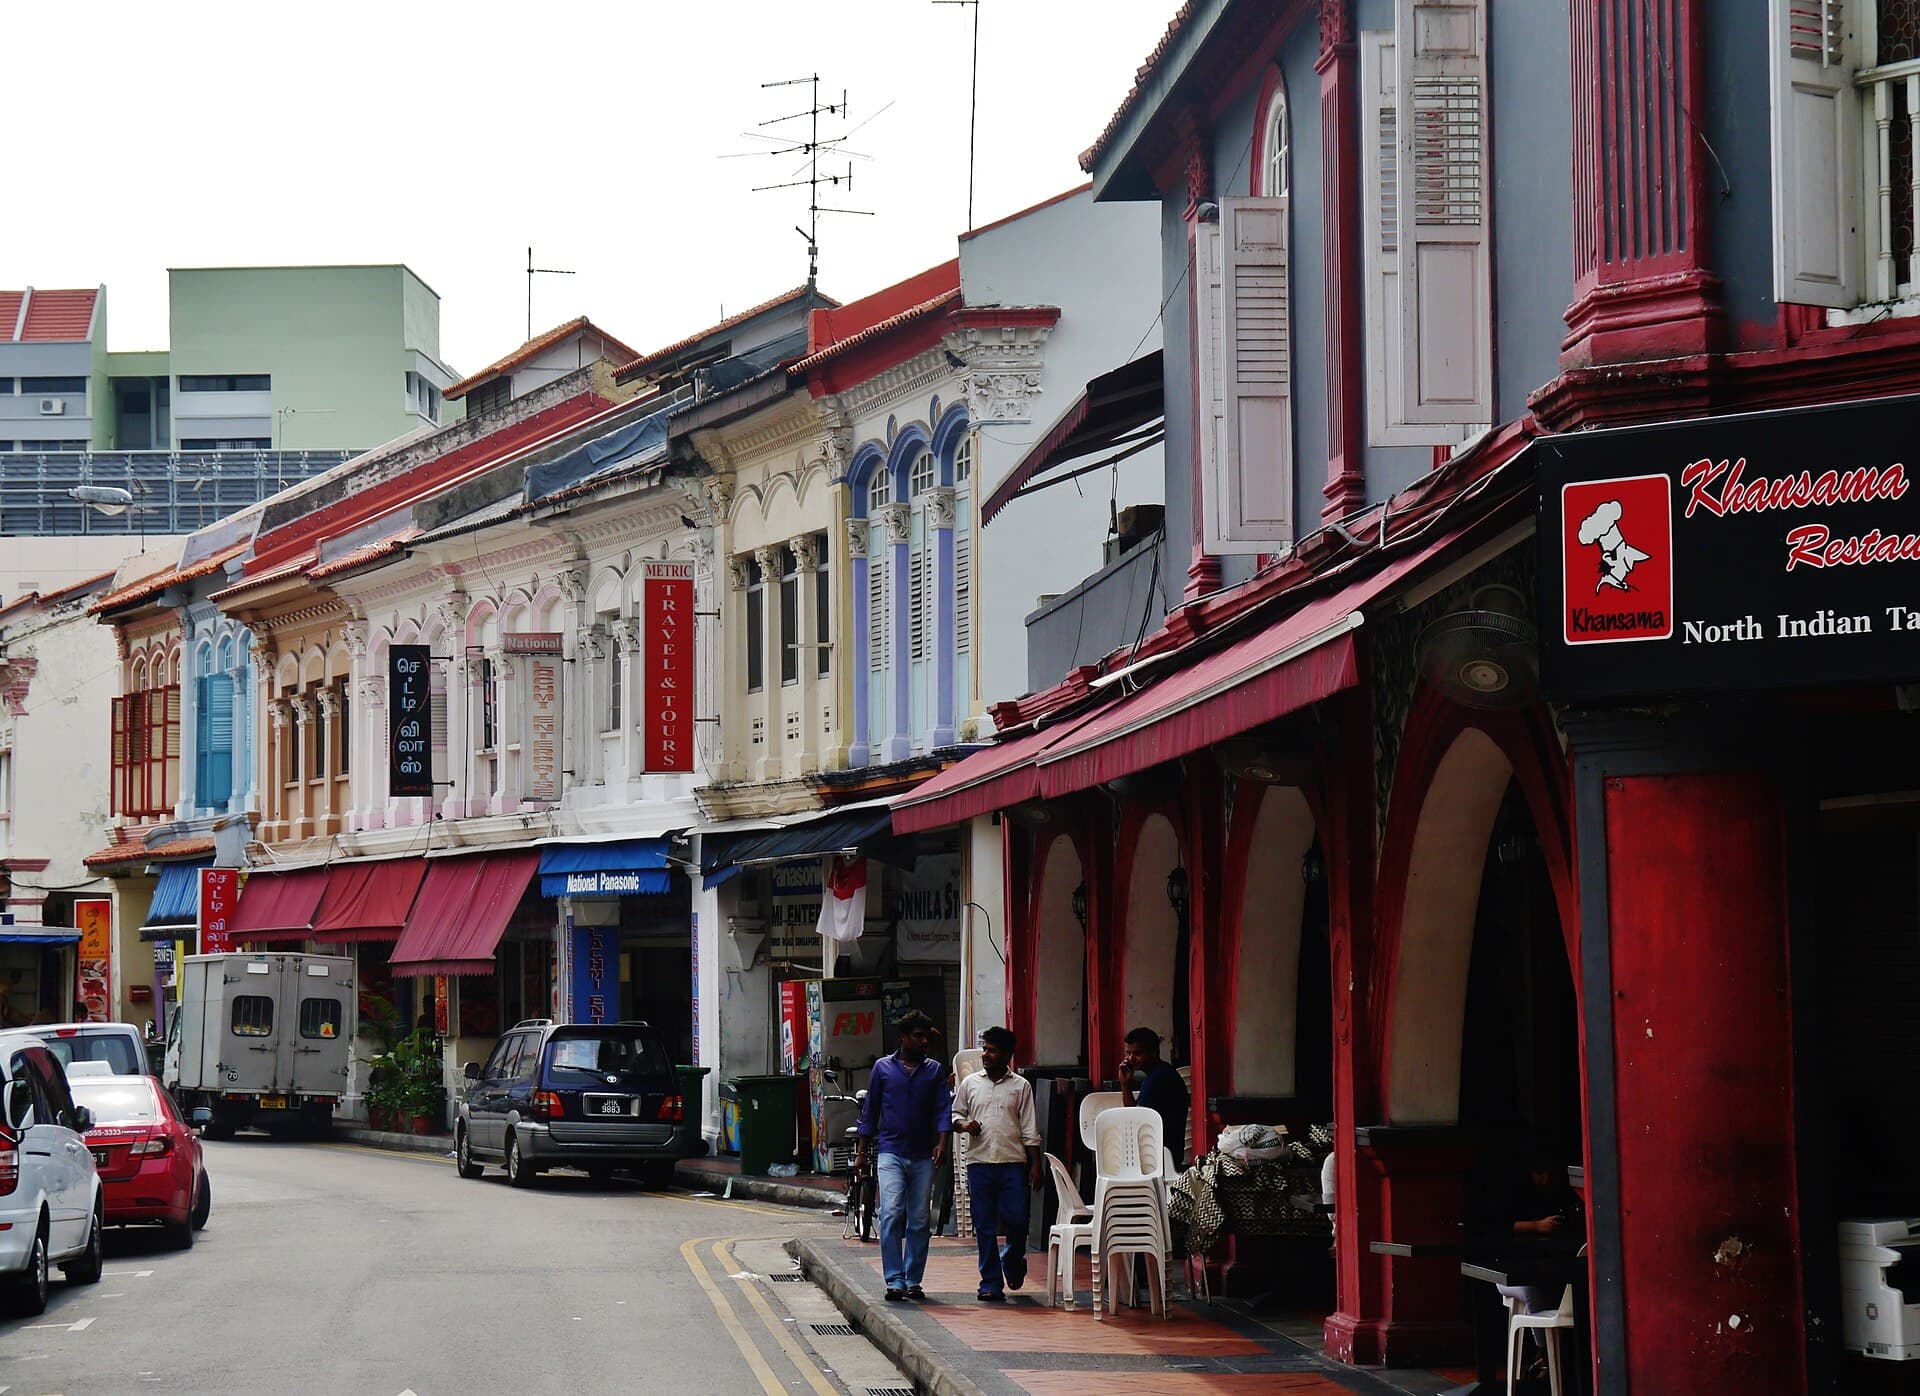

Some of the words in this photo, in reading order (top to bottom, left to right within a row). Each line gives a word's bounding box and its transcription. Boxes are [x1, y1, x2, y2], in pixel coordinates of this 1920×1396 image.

[1681, 457, 1910, 519] Khansama
[646, 563, 691, 578] METRIC
[660, 583, 677, 670] TRAVEL
[1571, 607, 1665, 633] Khansama
[1682, 615, 1763, 645] North
[1777, 610, 1872, 639] Indian
[1886, 606, 1920, 631] Ta
[506, 636, 561, 651] National
[660, 676, 676, 690] &
[660, 695, 678, 767] TOURS
[566, 873, 598, 893] National
[599, 870, 640, 891] Panasonic
